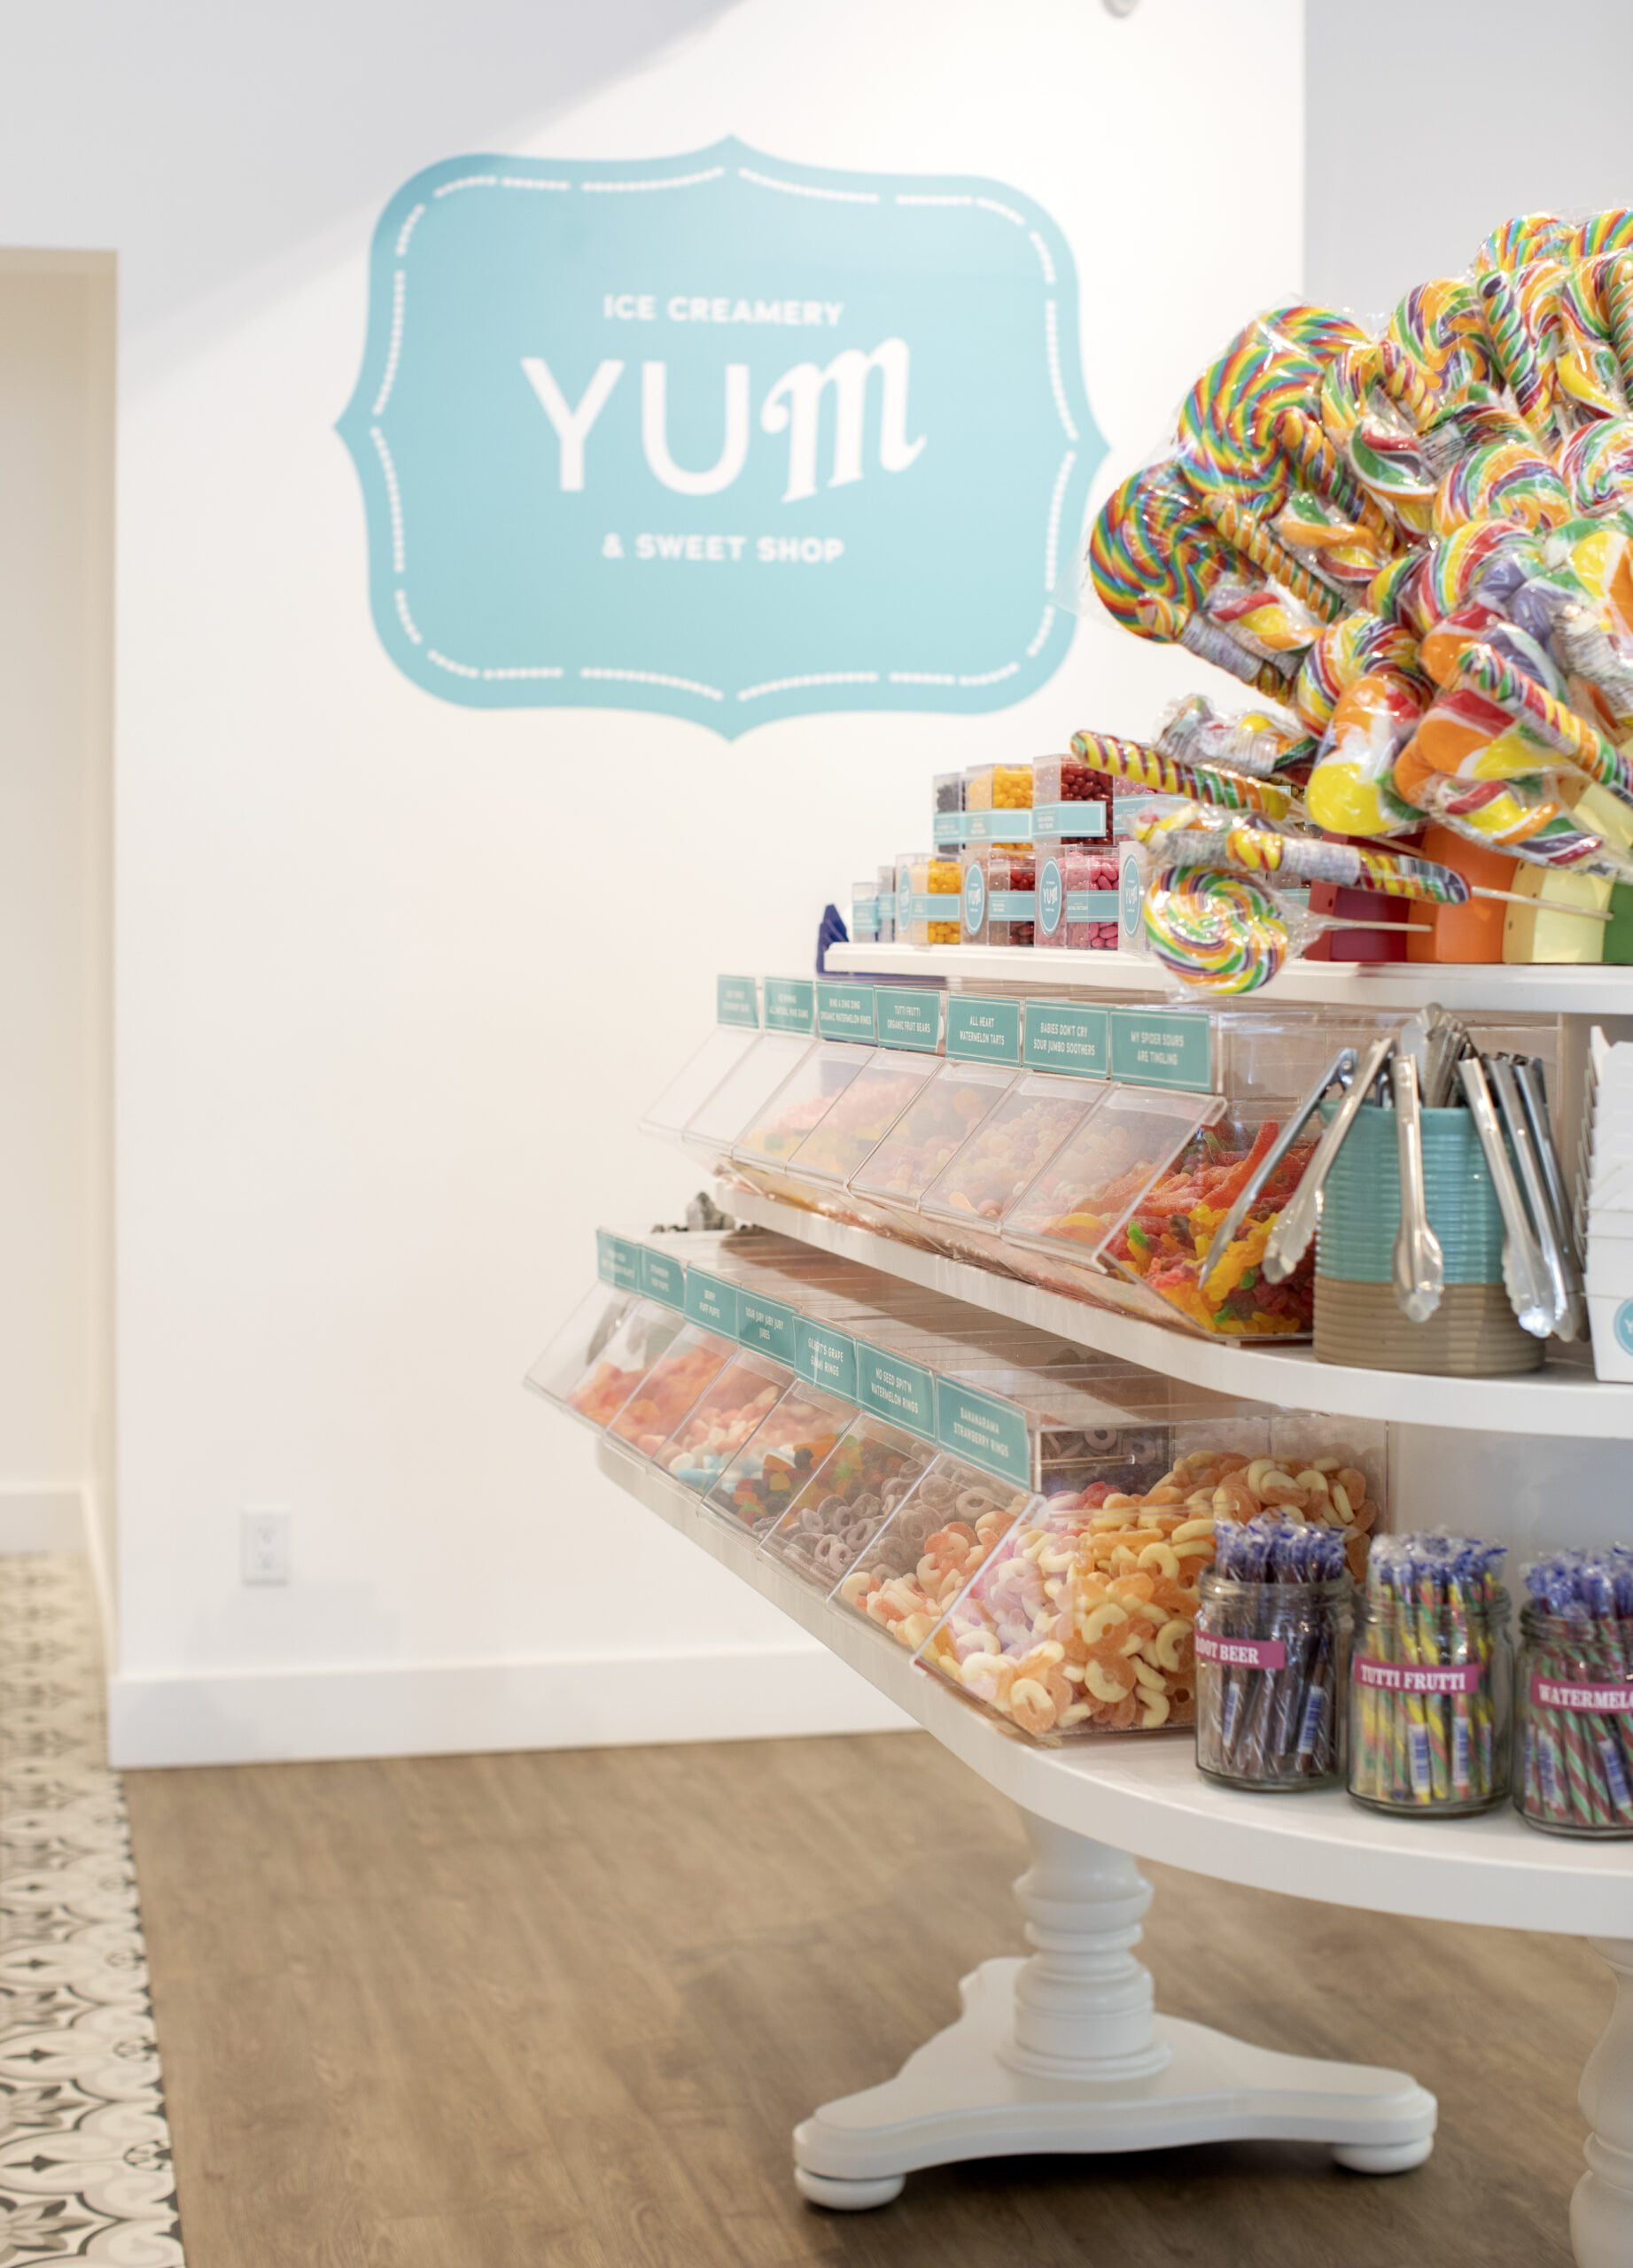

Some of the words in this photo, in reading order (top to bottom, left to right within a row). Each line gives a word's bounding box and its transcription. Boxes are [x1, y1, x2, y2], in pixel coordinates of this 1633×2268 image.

[603, 295, 656, 320] ICE
[668, 296, 843, 327] CREAMERY
[602, 533, 622, 559] &
[636, 535, 746, 562] SWEET
[759, 537, 844, 563] SHOP
[894, 1006, 906, 1015] TUTTI
[906, 1006, 921, 1017] FRUTTI
[888, 1020, 904, 1029] ORGANIC
[905, 1021, 916, 1031] FRUIT
[917, 1022, 930, 1033] BEARS
[969, 1016, 978, 1026] ALL
[979, 1017, 994, 1029] HEART
[1040, 1022, 1058, 1035] BABIES
[1060, 1024, 1075, 1037] DON'T
[1077, 1026, 1088, 1037] CRY
[960, 1030, 989, 1044] WATERMELON
[990, 1035, 1005, 1045] TARTS
[1131, 1031, 1140, 1043] MY
[1141, 1032, 1162, 1045] SPIDER
[1163, 1034, 1184, 1048] SOURS
[1033, 1038, 1047, 1051] SOUR
[1047, 1040, 1064, 1053] JUMBO
[1066, 1042, 1095, 1056] SOOTHERS
[1137, 1050, 1148, 1062] ARE
[1150, 1052, 1178, 1066] TINGLING
[828, 1348, 844, 1363] GRAPE
[824, 1363, 839, 1377] RINGS
[875, 1367, 883, 1380] NO
[883, 1371, 895, 1386] SEED
[895, 1377, 912, 1394] SPIT'N
[871, 1382, 901, 1407] WATERMELON
[902, 1396, 918, 1414] RINGS
[960, 1406, 999, 1434] BANANARAMA
[953, 1422, 990, 1449] STRAWBERRY
[991, 1438, 1009, 1458] RINGS
[1219, 1643, 1259, 1665] BEER
[1360, 1665, 1400, 1688] TUTTI
[1404, 1672, 1466, 1690] FRUTTI
